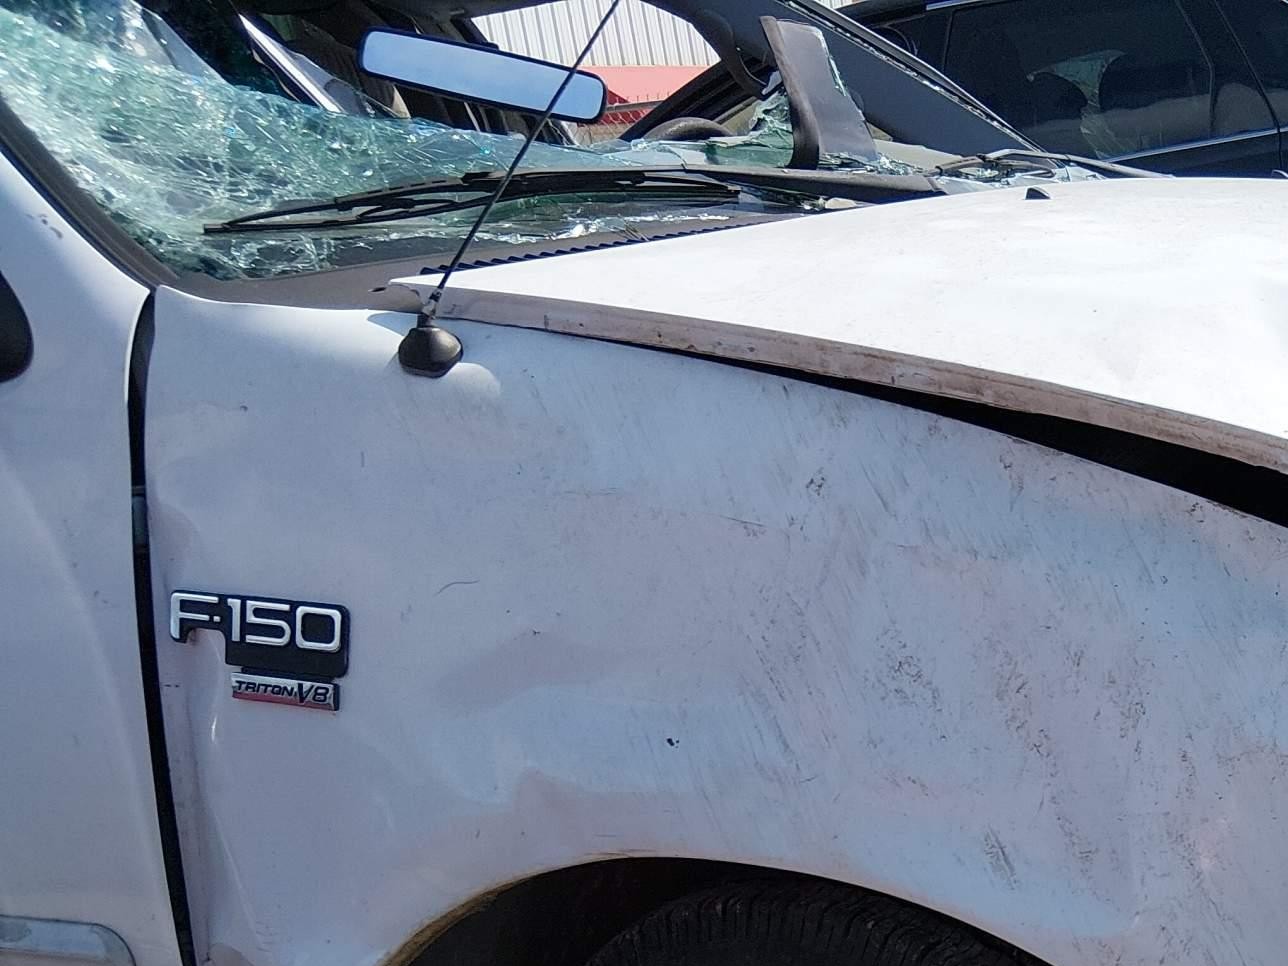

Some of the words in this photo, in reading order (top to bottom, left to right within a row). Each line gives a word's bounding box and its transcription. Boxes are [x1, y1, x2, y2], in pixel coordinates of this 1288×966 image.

[170, 592, 342, 652] F-150
[235, 680, 296, 698] TRITON
[297, 683, 330, 704] V8
